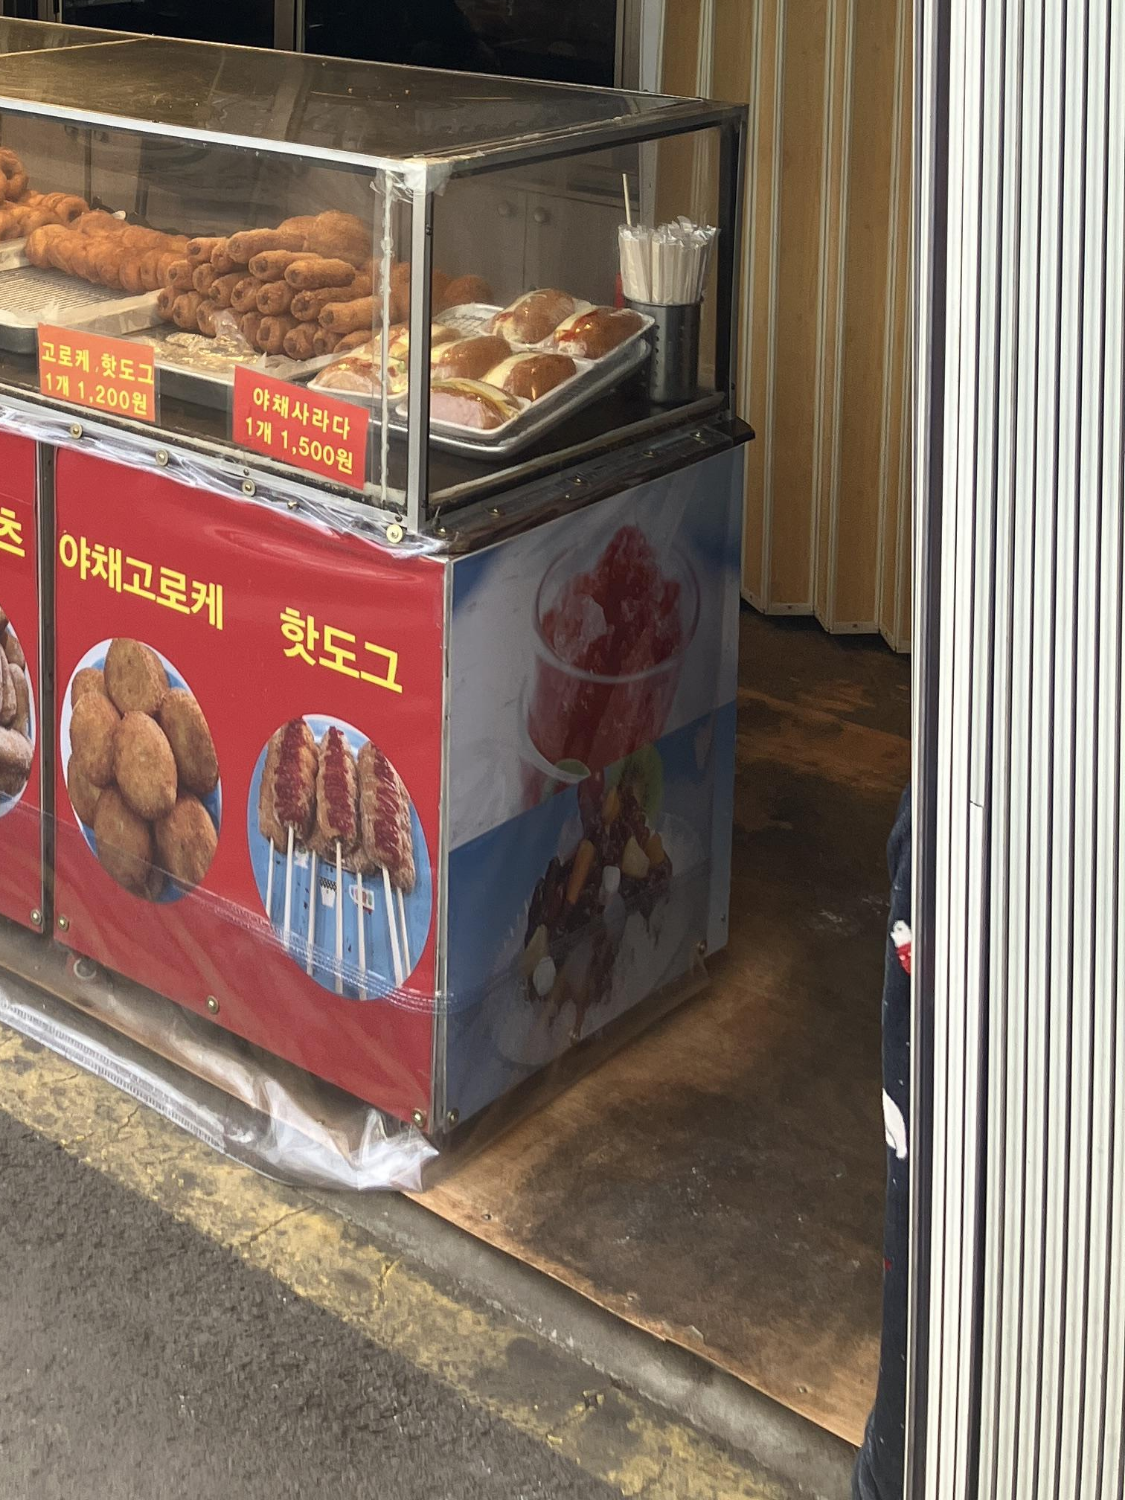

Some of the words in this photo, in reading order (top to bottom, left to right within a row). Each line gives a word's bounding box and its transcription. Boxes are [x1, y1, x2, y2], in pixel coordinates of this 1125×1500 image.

[45, 373, 69, 397] 1개
[77, 382, 147, 415] 1,200원
[253, 387, 350, 440] 야채사라다
[246, 417, 272, 445] 1개
[281, 430, 353, 475] 1,500원
[59, 533, 223, 630] 야채고로케
[280, 607, 402, 693] 핫도그
